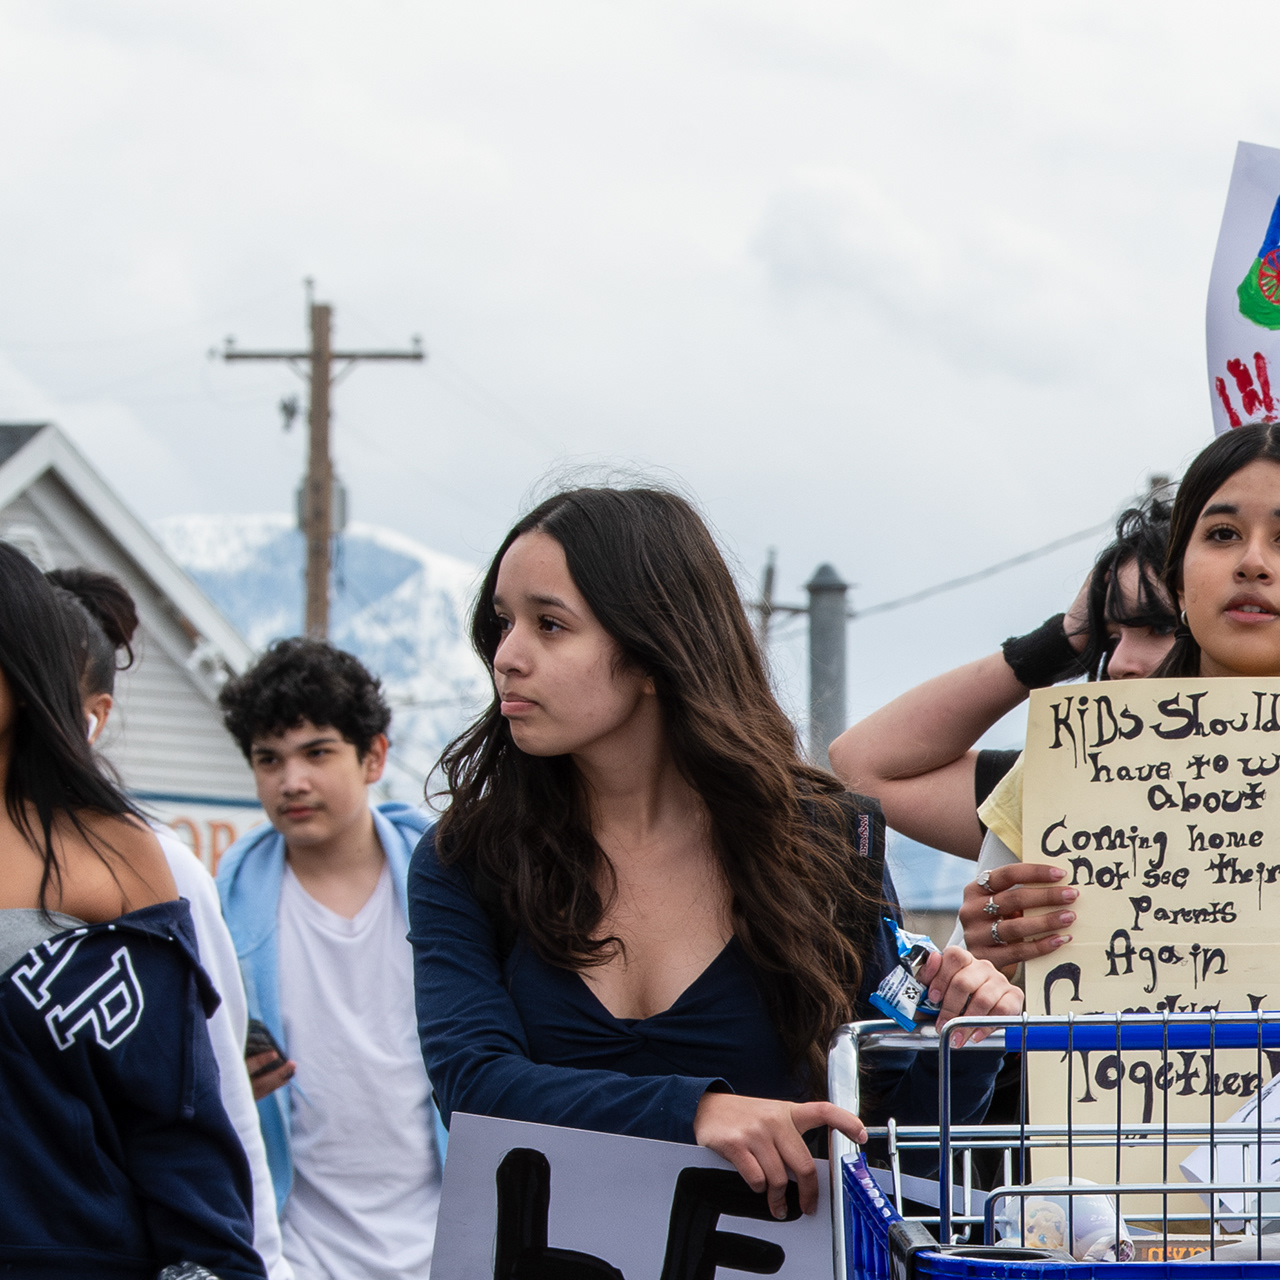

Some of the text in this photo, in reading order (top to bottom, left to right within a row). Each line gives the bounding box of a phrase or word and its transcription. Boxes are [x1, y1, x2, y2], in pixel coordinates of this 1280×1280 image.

[1088, 751, 1173, 783] have
[1186, 753, 1229, 781] to
[1041, 815, 1169, 878] Coming
[1187, 823, 1265, 853] home
[1142, 866, 1191, 890] see
[1104, 928, 1229, 994] Again
